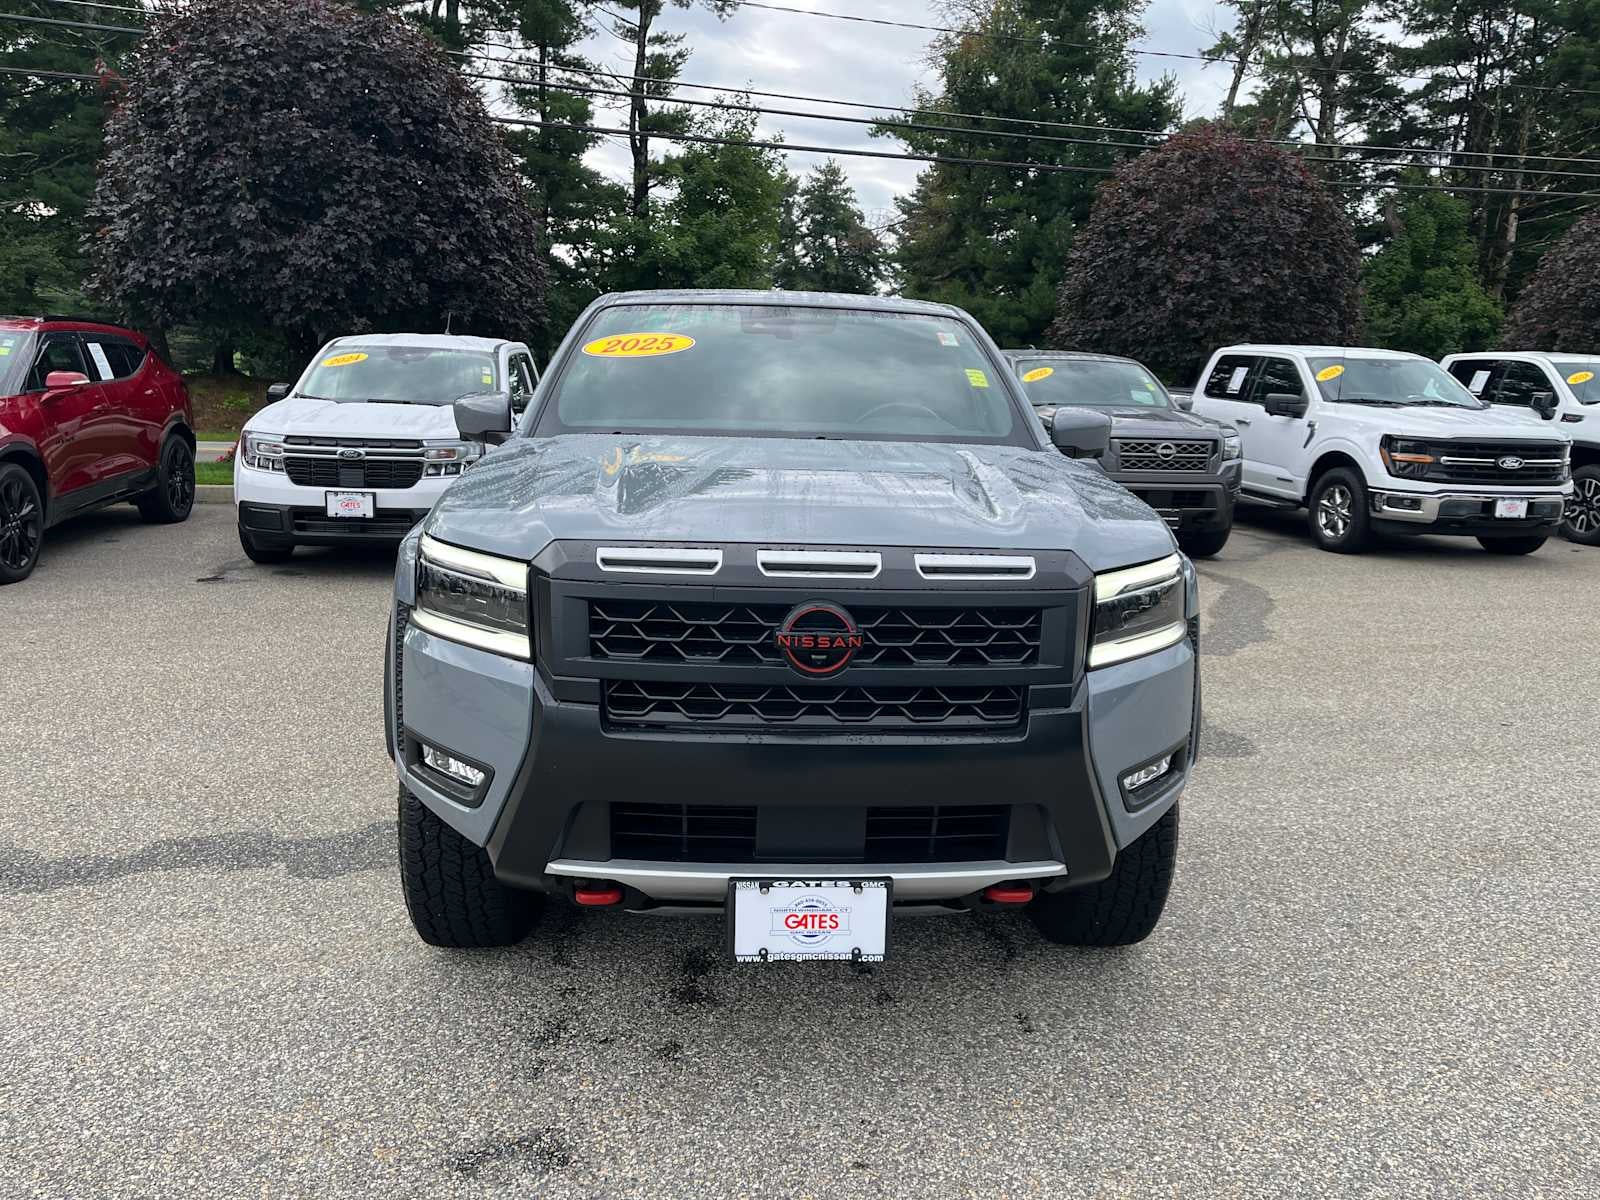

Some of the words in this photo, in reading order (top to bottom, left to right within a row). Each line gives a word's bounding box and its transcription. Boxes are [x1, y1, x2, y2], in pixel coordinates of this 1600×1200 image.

[601, 337, 677, 353] 2025
[777, 635, 862, 648] NISSAN
[736, 881, 759, 889] NISSAN
[772, 880, 851, 888] GATES
[784, 913, 839, 930] GATES
[736, 954, 764, 963] www.
